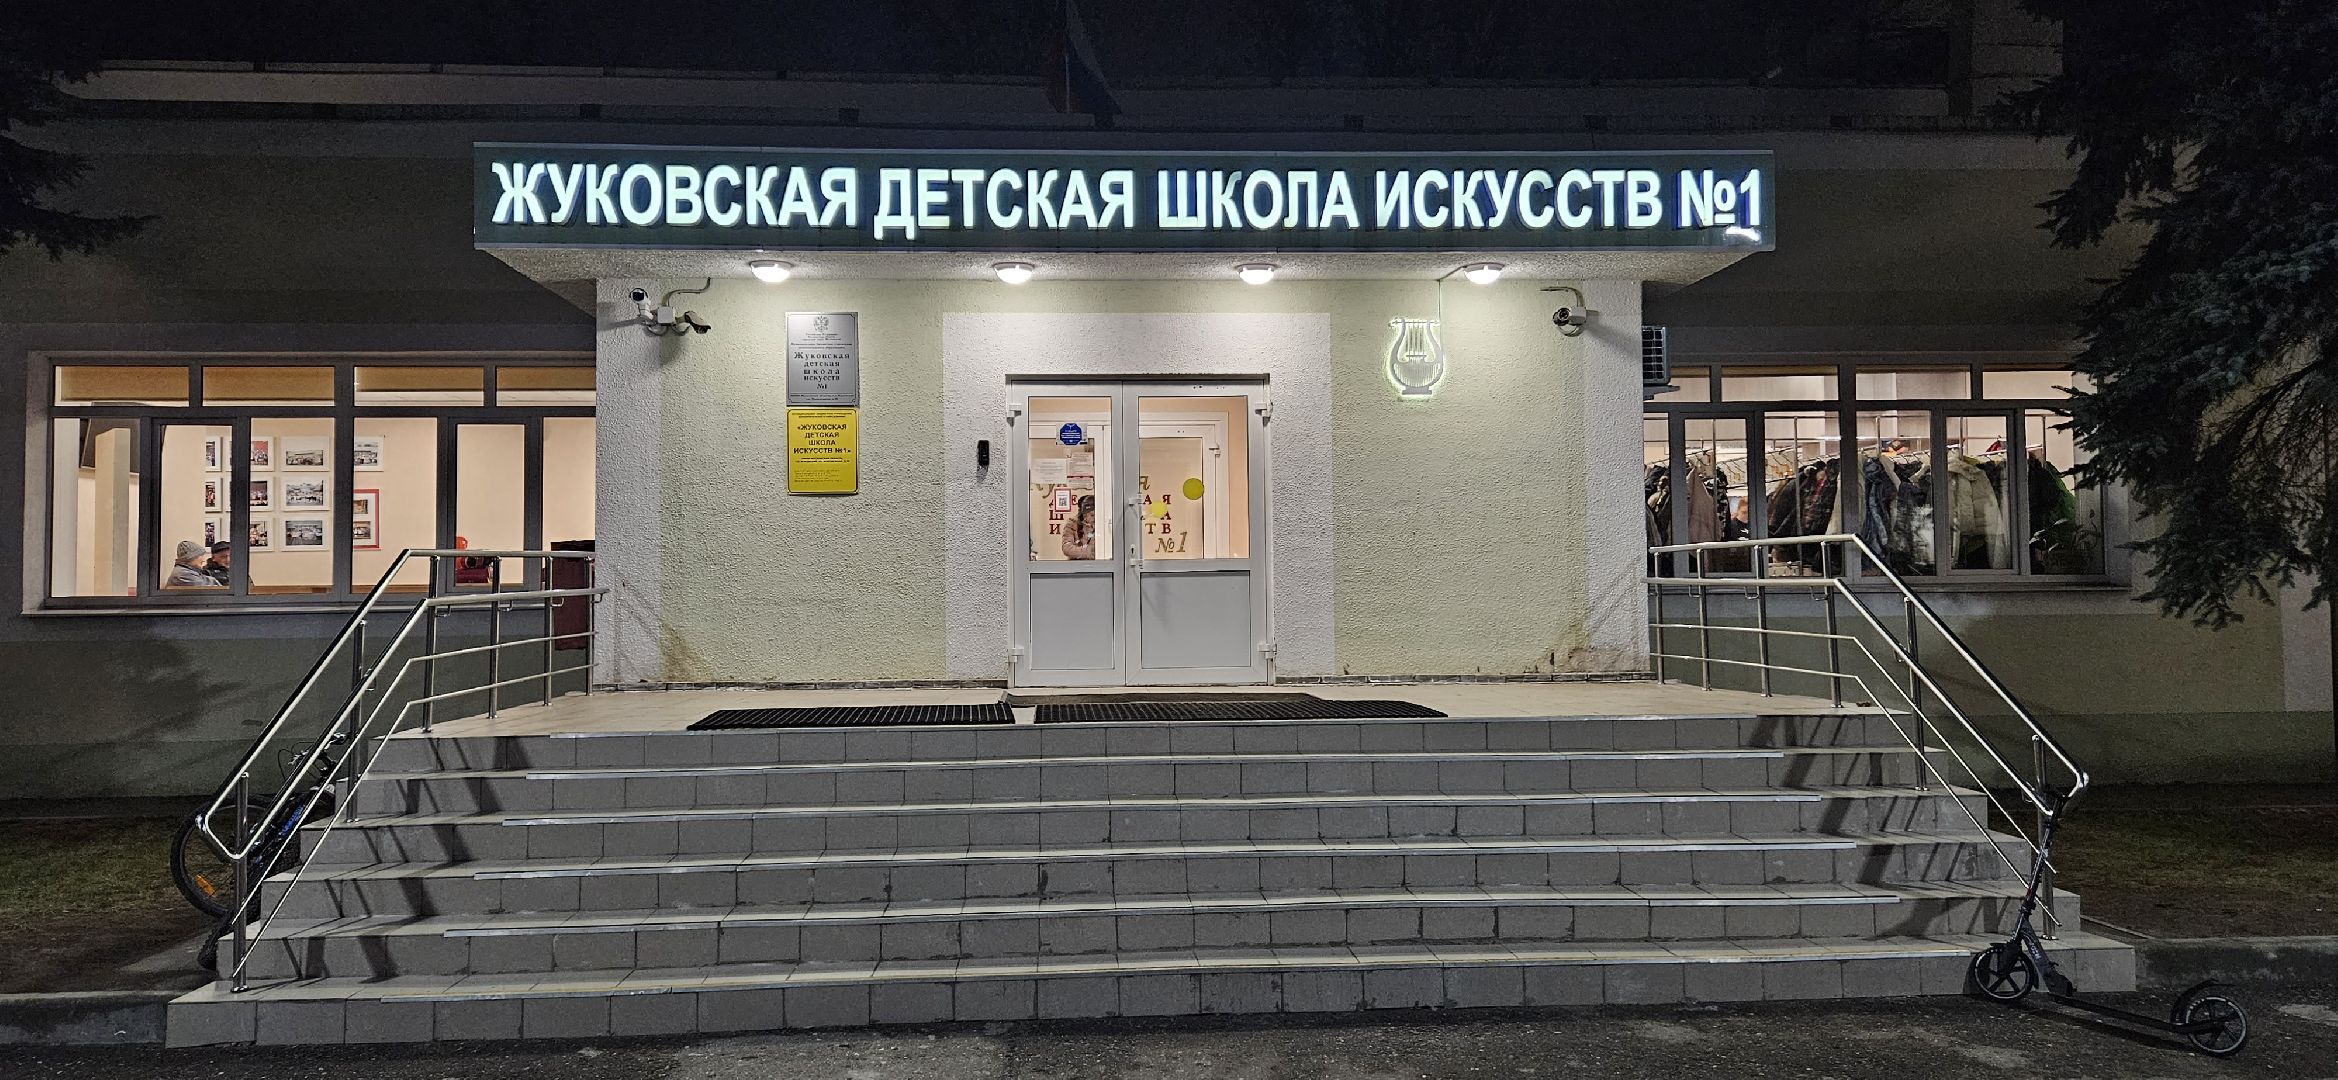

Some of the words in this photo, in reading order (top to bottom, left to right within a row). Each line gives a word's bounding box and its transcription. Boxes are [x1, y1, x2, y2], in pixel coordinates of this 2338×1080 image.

[491, 162, 857, 228] ЖУКОВСКАЯ
[874, 167, 1134, 240] ДЕТСКАЯ
[1157, 169, 1360, 230] ШКОЛА
[1375, 169, 1662, 230] ИСКУССТВ
[1680, 169, 1762, 230] №1
[794, 352, 850, 360] Жуковская
